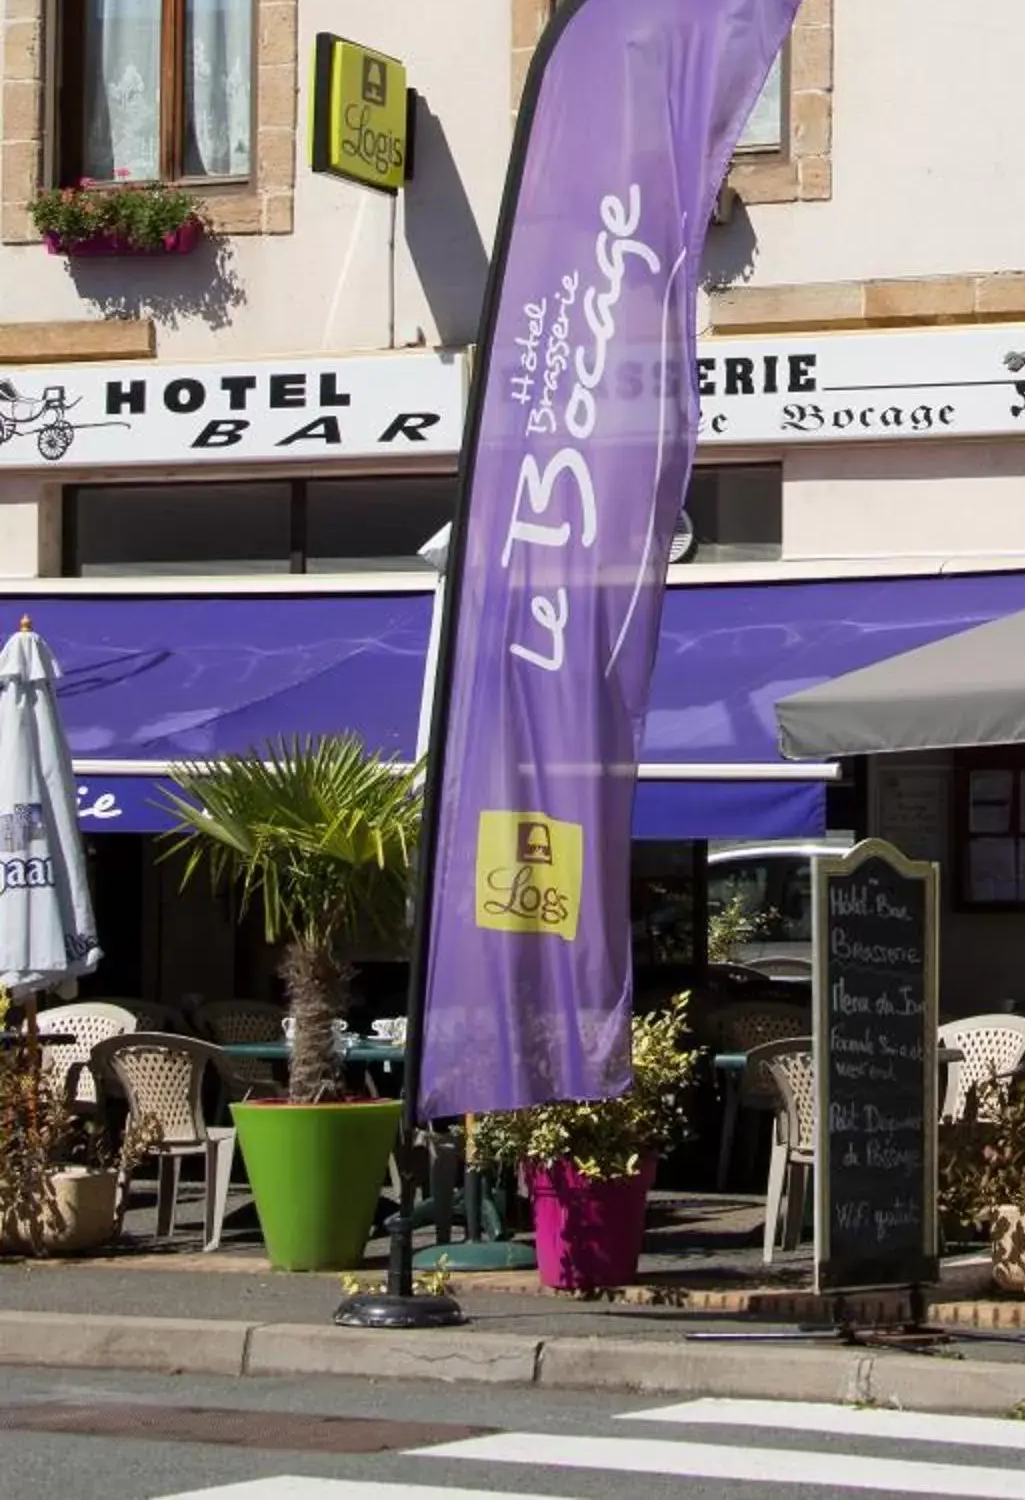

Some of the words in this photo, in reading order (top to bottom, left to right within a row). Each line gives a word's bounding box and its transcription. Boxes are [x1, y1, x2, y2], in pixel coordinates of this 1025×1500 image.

[341, 103, 403, 175] Logis
[500, 184, 659, 568] Bocage
[510, 297, 547, 405] Hôtel
[525, 268, 579, 437] Brasserie
[106, 372, 351, 415] HOTEL
[190, 413, 441, 449] BAR
[781, 402, 956, 432] Bocage
[509, 587, 572, 671] Le
